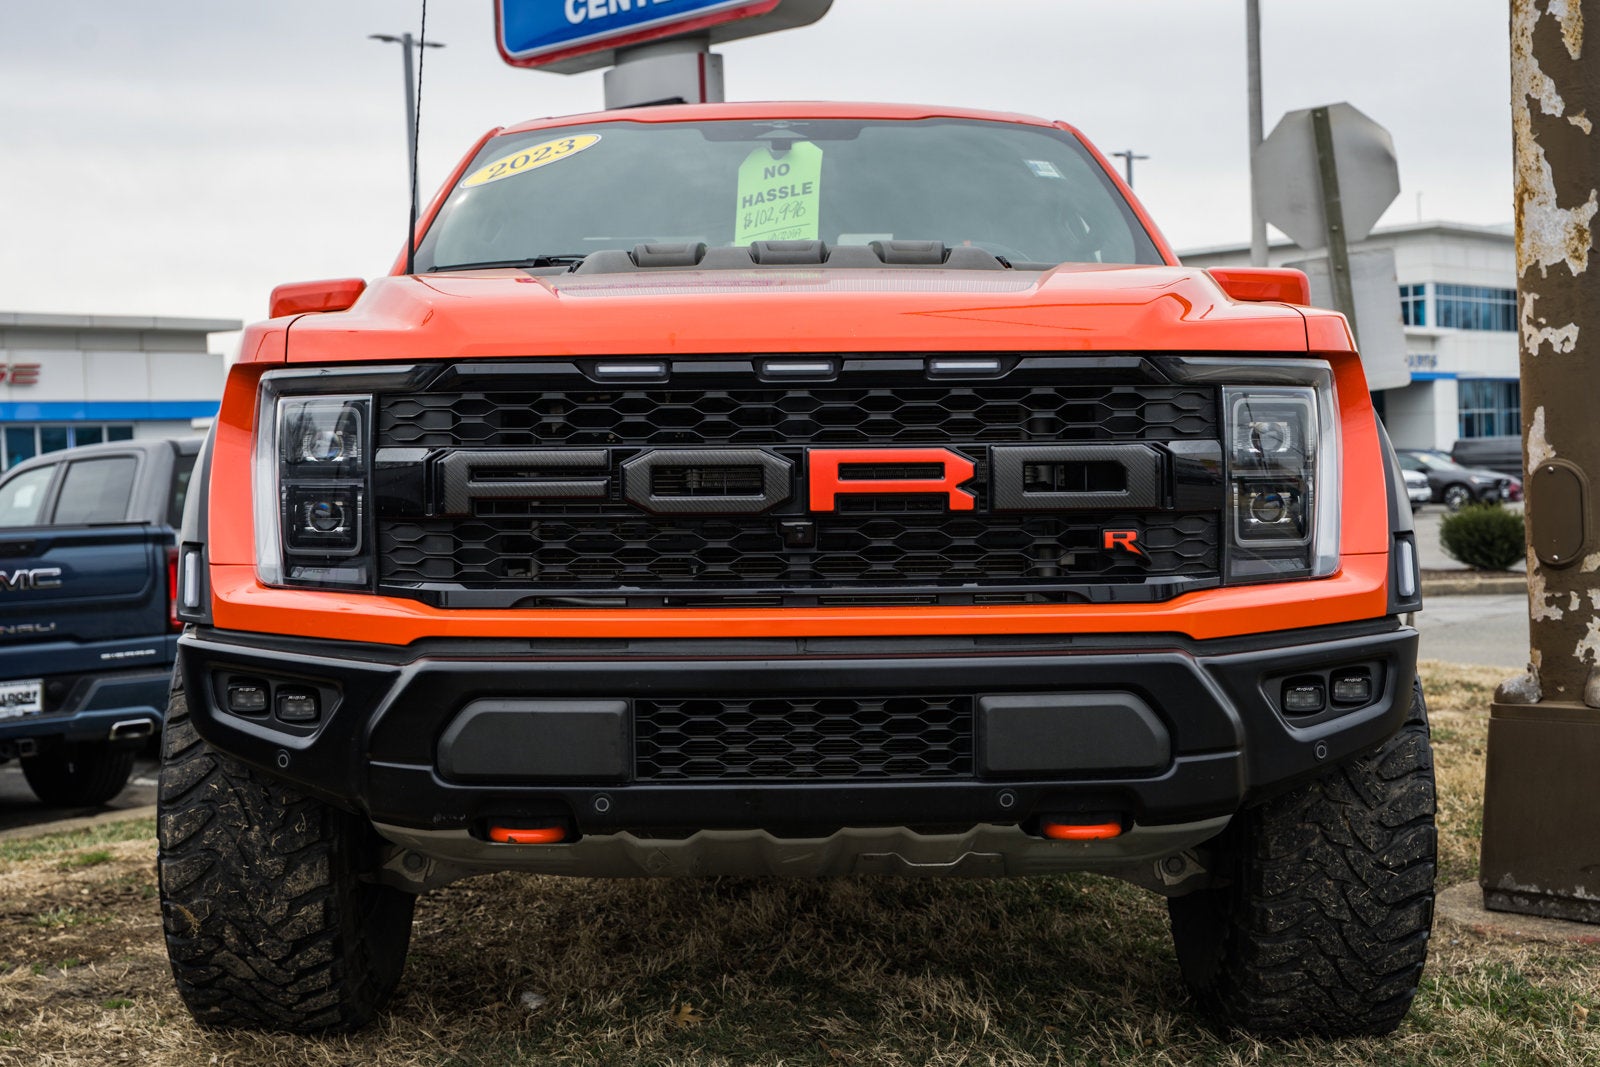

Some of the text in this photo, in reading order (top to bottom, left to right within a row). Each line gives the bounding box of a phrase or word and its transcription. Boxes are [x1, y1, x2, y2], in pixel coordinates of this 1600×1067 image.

[487, 138, 576, 180] 2023
[763, 163, 791, 180] NO
[742, 182, 813, 209] HASSLE
[442, 446, 1161, 515] FORD
[1103, 529, 1145, 558] R
